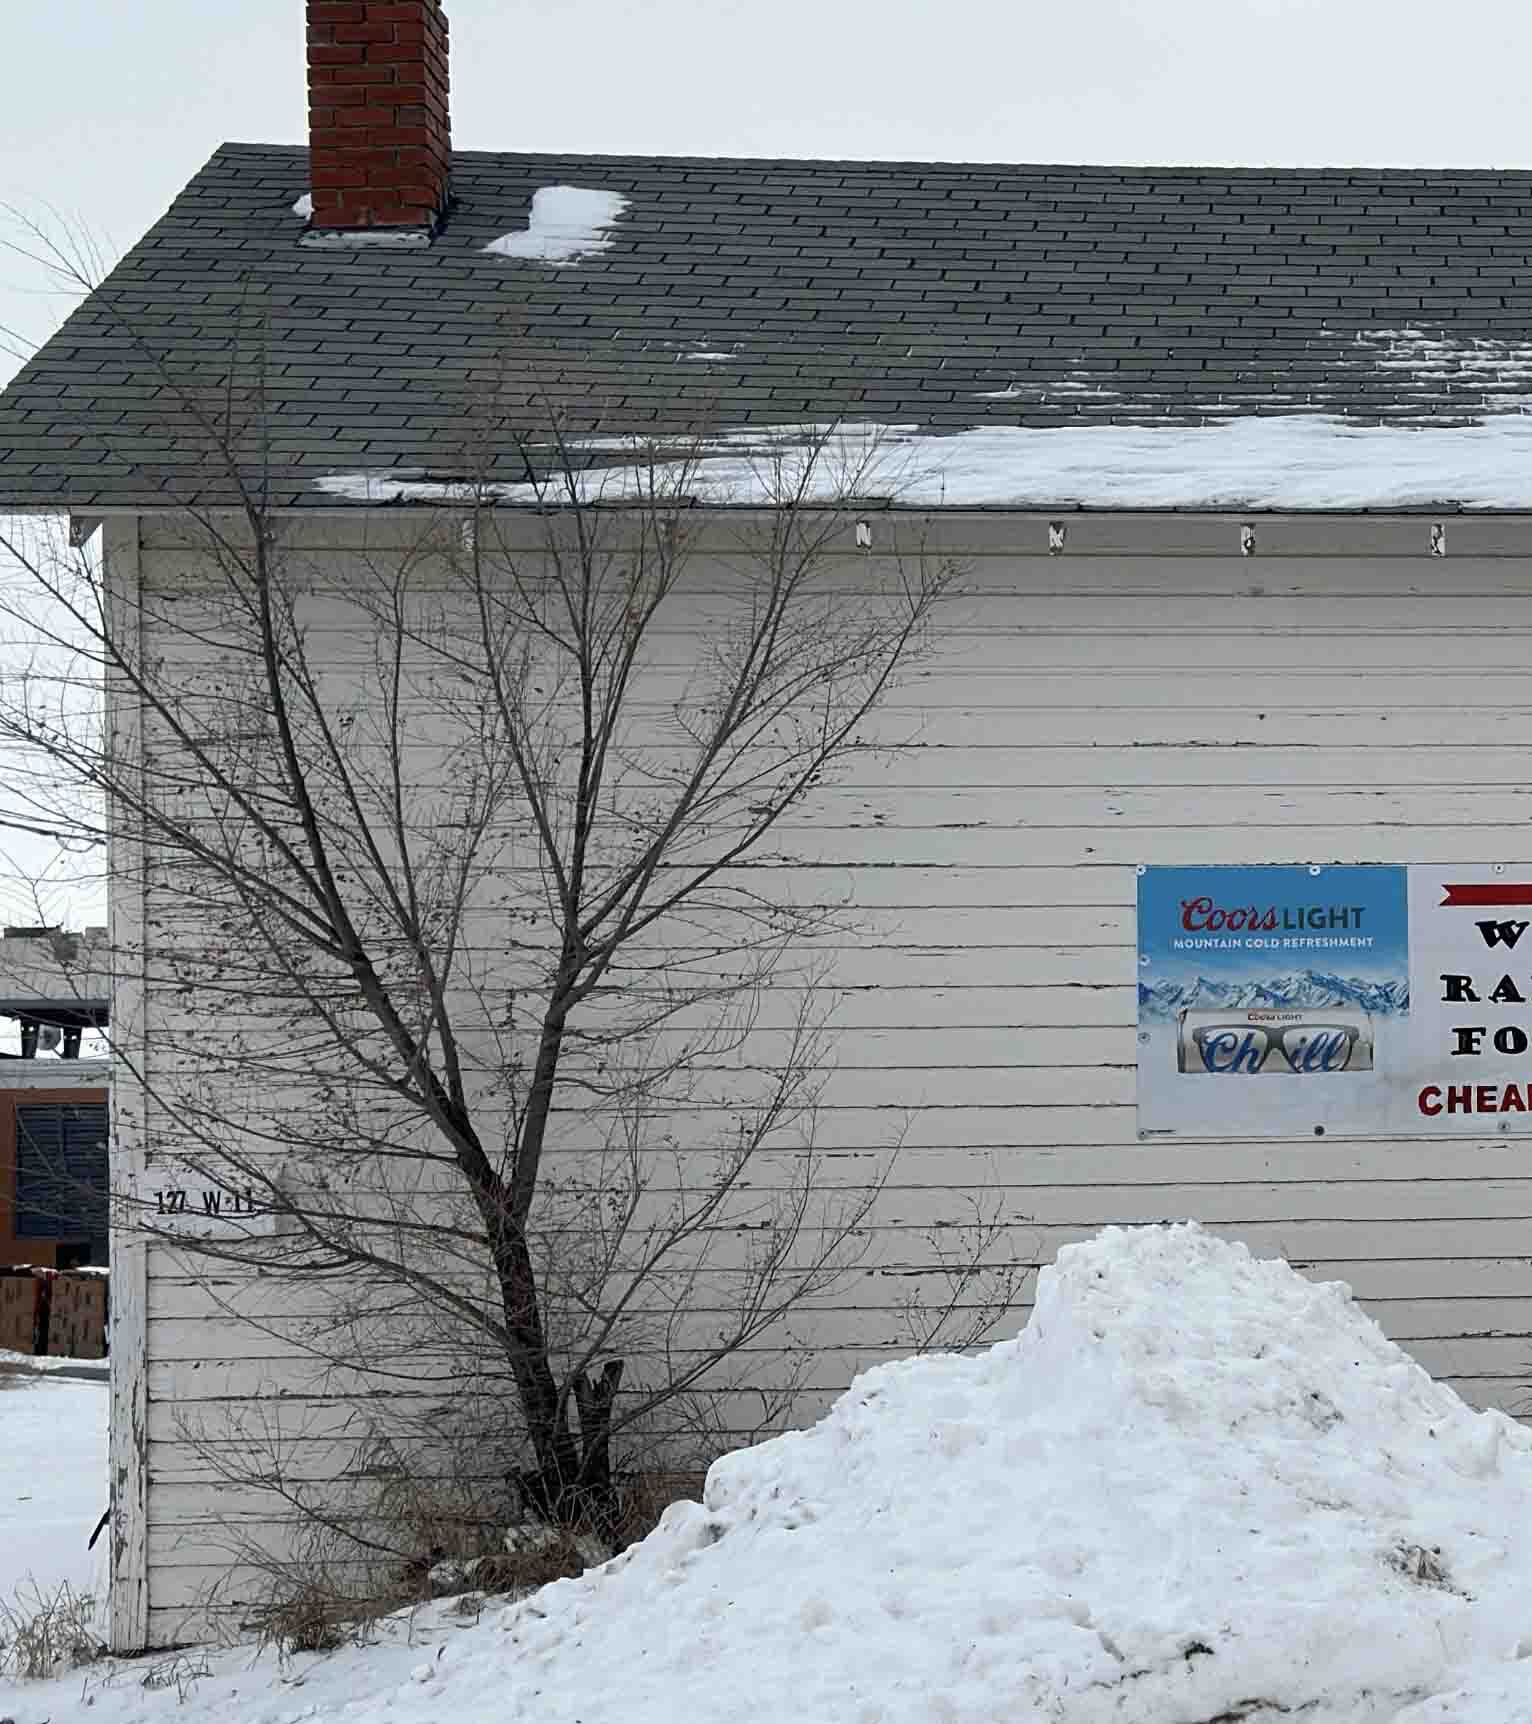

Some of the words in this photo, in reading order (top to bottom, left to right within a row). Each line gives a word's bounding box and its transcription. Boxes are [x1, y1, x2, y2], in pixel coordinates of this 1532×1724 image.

[1180, 895, 1280, 932] Coors
[1282, 906, 1366, 930] LIGHT
[1173, 938, 1242, 950] MOUNTAIN
[1245, 938, 1280, 949] COLD
[1283, 936, 1374, 949] REFRESHMENT
[203, 1191, 220, 1214] W
